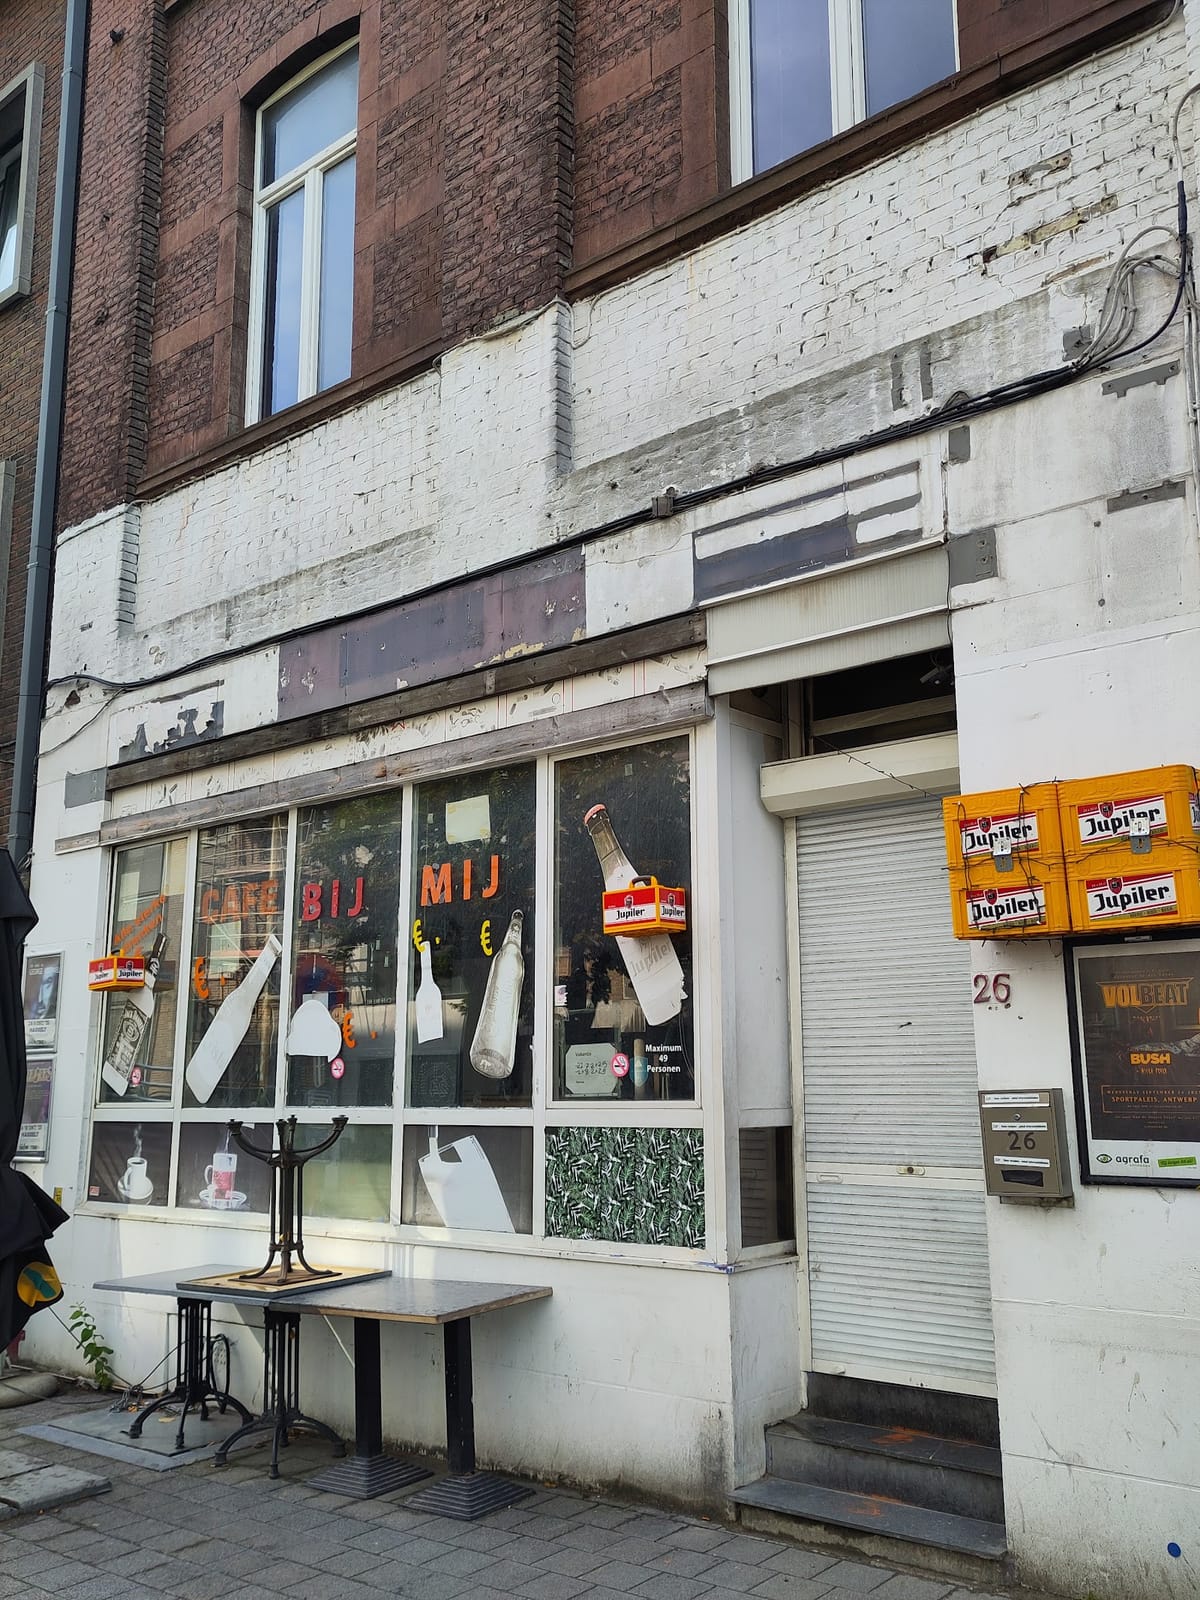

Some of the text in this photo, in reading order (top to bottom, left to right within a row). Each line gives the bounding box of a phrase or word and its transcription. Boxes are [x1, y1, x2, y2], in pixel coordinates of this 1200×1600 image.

[201, 854, 499, 923] CAFE BIJ MIJ
[1094, 885, 1170, 912] Jupiler
[616, 908, 645, 920] Jupiler
[661, 906, 684, 917] Jupiler
[972, 897, 1039, 921] Jupiler
[118, 970, 143, 978] Jupiler
[973, 973, 1011, 1003] 26
[1101, 982, 1189, 1009] VOLBEAT
[645, 1044, 682, 1052] Maximum
[1130, 1052, 1171, 1065] BUSH
[647, 1065, 681, 1073] Personen
[1008, 1131, 1036, 1150] 26
[1116, 1155, 1150, 1164] agrafa
